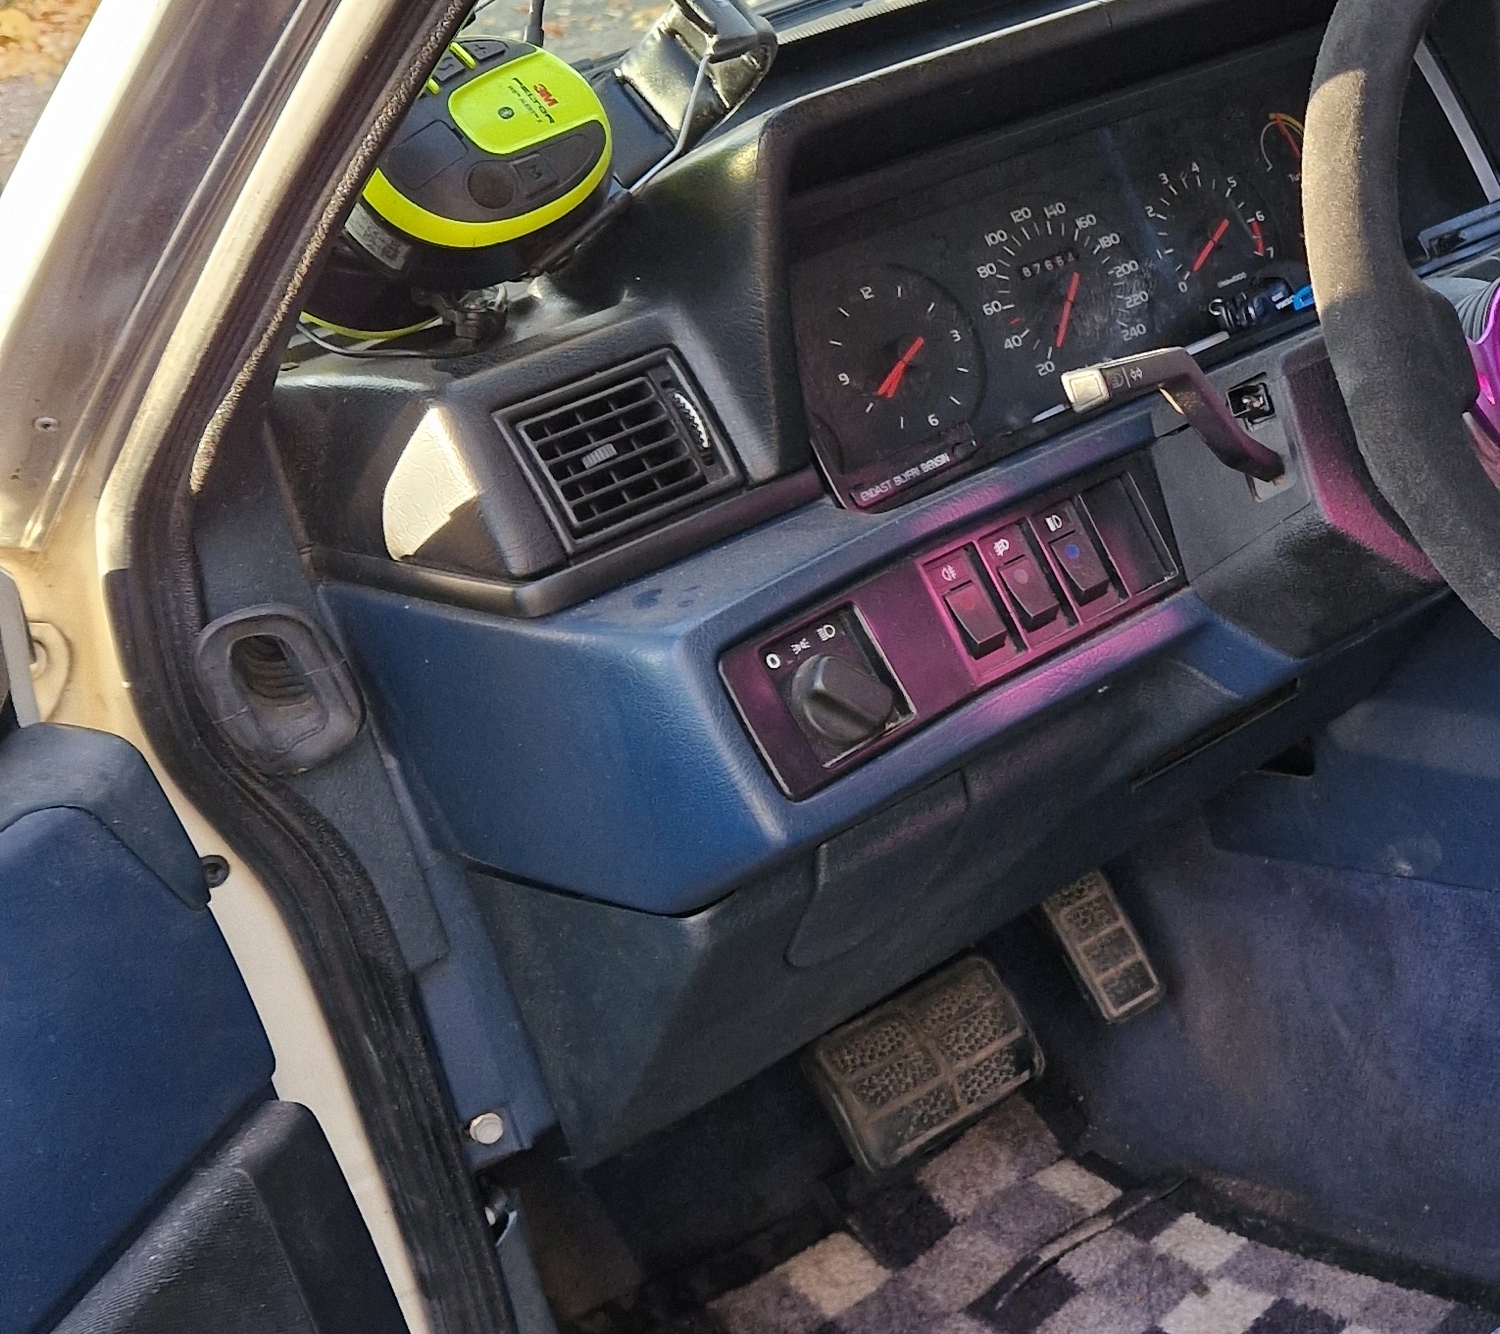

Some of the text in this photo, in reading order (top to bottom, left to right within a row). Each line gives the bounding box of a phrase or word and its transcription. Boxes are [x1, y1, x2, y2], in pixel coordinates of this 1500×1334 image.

[512, 77, 555, 124] PELTOR
[533, 82, 559, 107] 3M
[1191, 162, 1200, 173] 4
[1158, 173, 1169, 185] 3
[1227, 176, 1238, 188] 5
[1010, 206, 1032, 224] 120
[1043, 202, 1066, 218] 140
[1144, 205, 1156, 218] 2
[1255, 210, 1265, 222] 6
[1075, 214, 1097, 230] 160
[984, 230, 1008, 247] 100
[1099, 233, 1121, 249] 180
[1265, 246, 1275, 259] 7
[976, 262, 997, 279] 80
[1114, 260, 1139, 278] 200
[859, 285, 875, 300] 12
[1178, 281, 1188, 293] 0
[1124, 290, 1149, 309] 220
[982, 300, 1002, 316] 60
[949, 329, 962, 343] 3
[1121, 323, 1147, 342] 240
[1004, 334, 1022, 350] 40
[1035, 361, 1056, 377] 20
[838, 372, 850, 386] 9
[928, 414, 940, 427] 6
[860, 480, 893, 502] ENDAST
[920, 452, 951, 474] BENSIN
